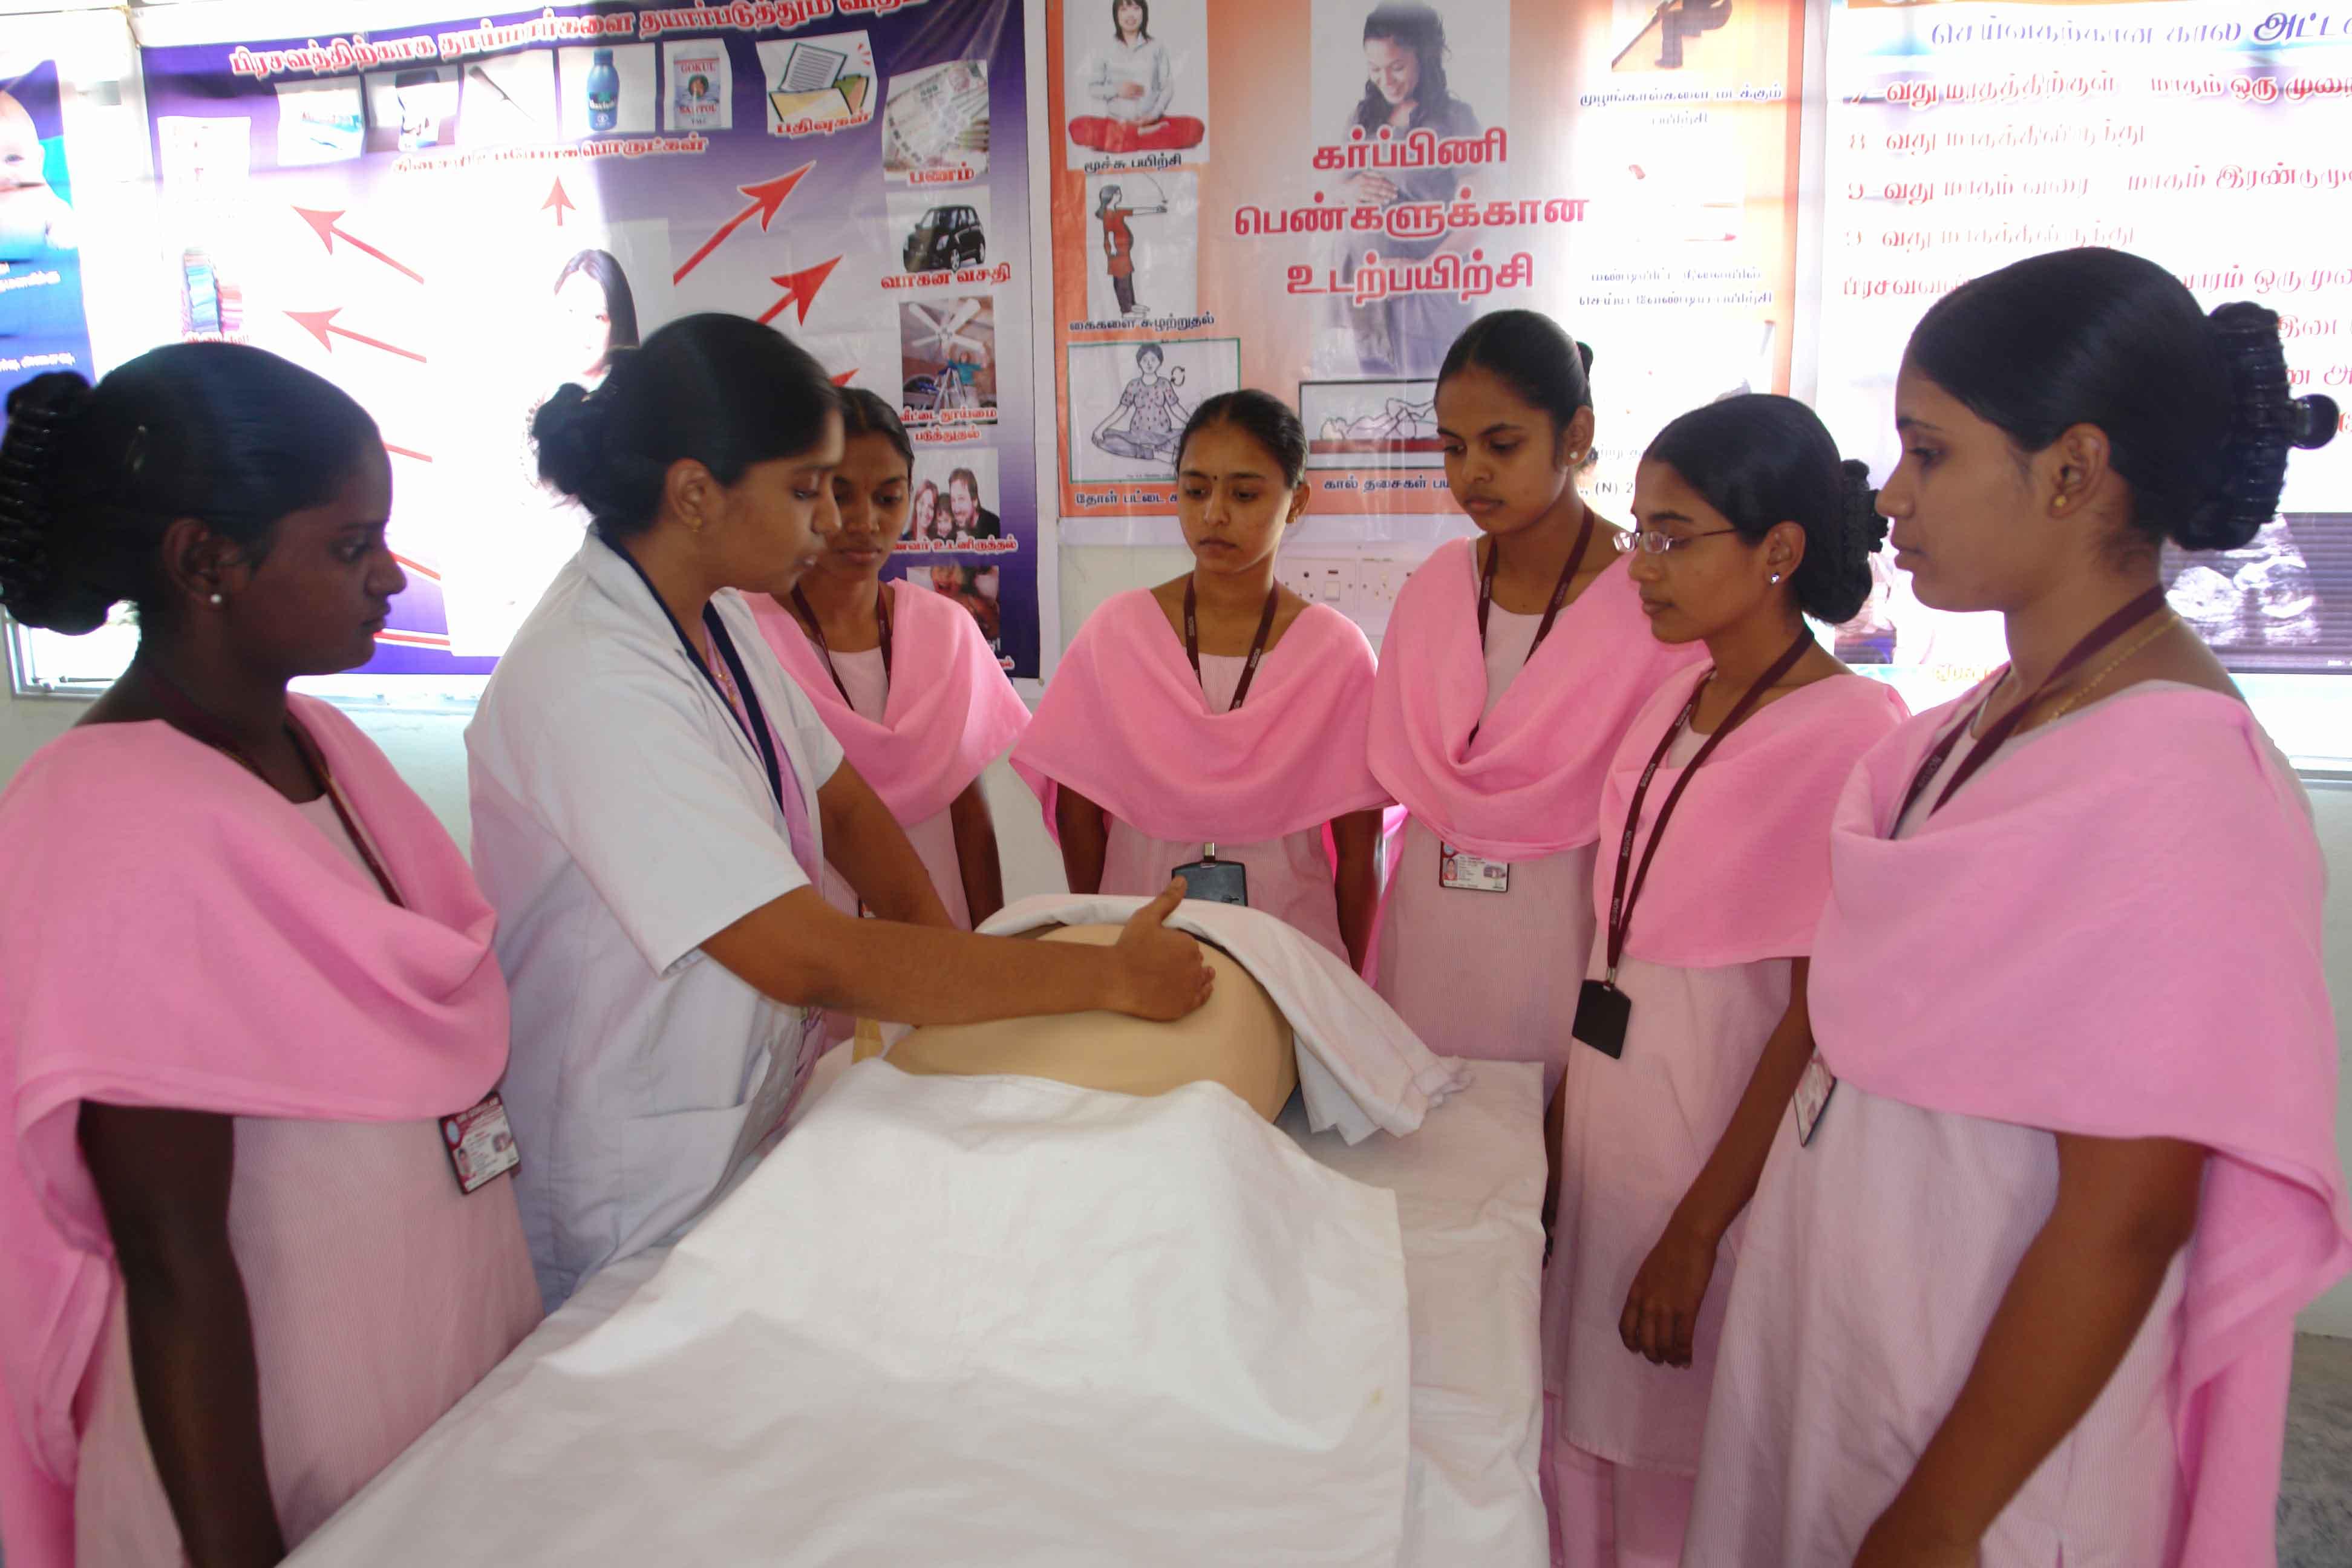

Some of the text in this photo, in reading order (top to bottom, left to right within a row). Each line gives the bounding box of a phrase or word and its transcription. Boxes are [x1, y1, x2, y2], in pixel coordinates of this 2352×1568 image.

[1313, 127, 1507, 169] கர்ப்பிணி
[910, 162, 974, 184] பணம்
[1235, 186, 1590, 238] பெண்களுக்கான
[881, 263, 1011, 289] வாகன வசதி
[1287, 248, 1534, 304] உடற்பயிற்சி
